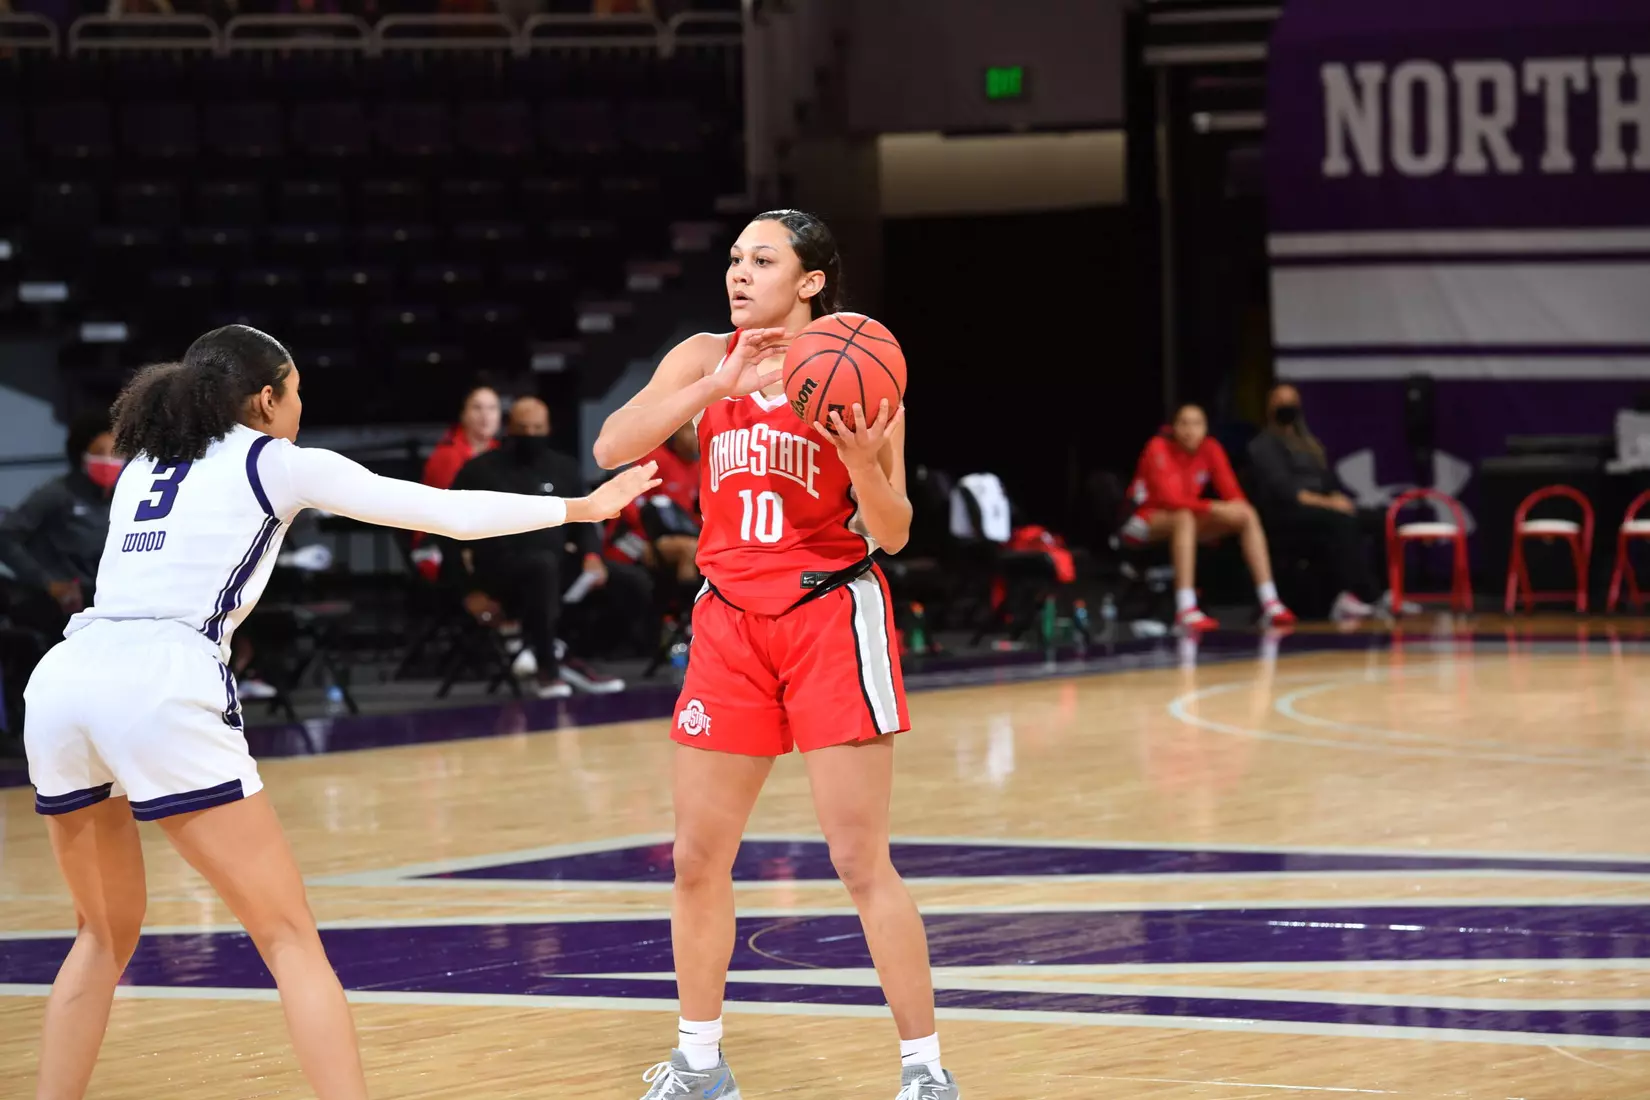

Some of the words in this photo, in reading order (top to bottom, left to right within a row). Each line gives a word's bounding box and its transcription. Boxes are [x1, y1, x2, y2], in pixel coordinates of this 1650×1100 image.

[1320, 57, 1650, 177] NORTH
[134, 457, 194, 522] 3
[709, 429, 750, 493] OHIO
[750, 423, 820, 499] STATE
[122, 531, 166, 552] WOOD
[738, 489, 783, 543] 10
